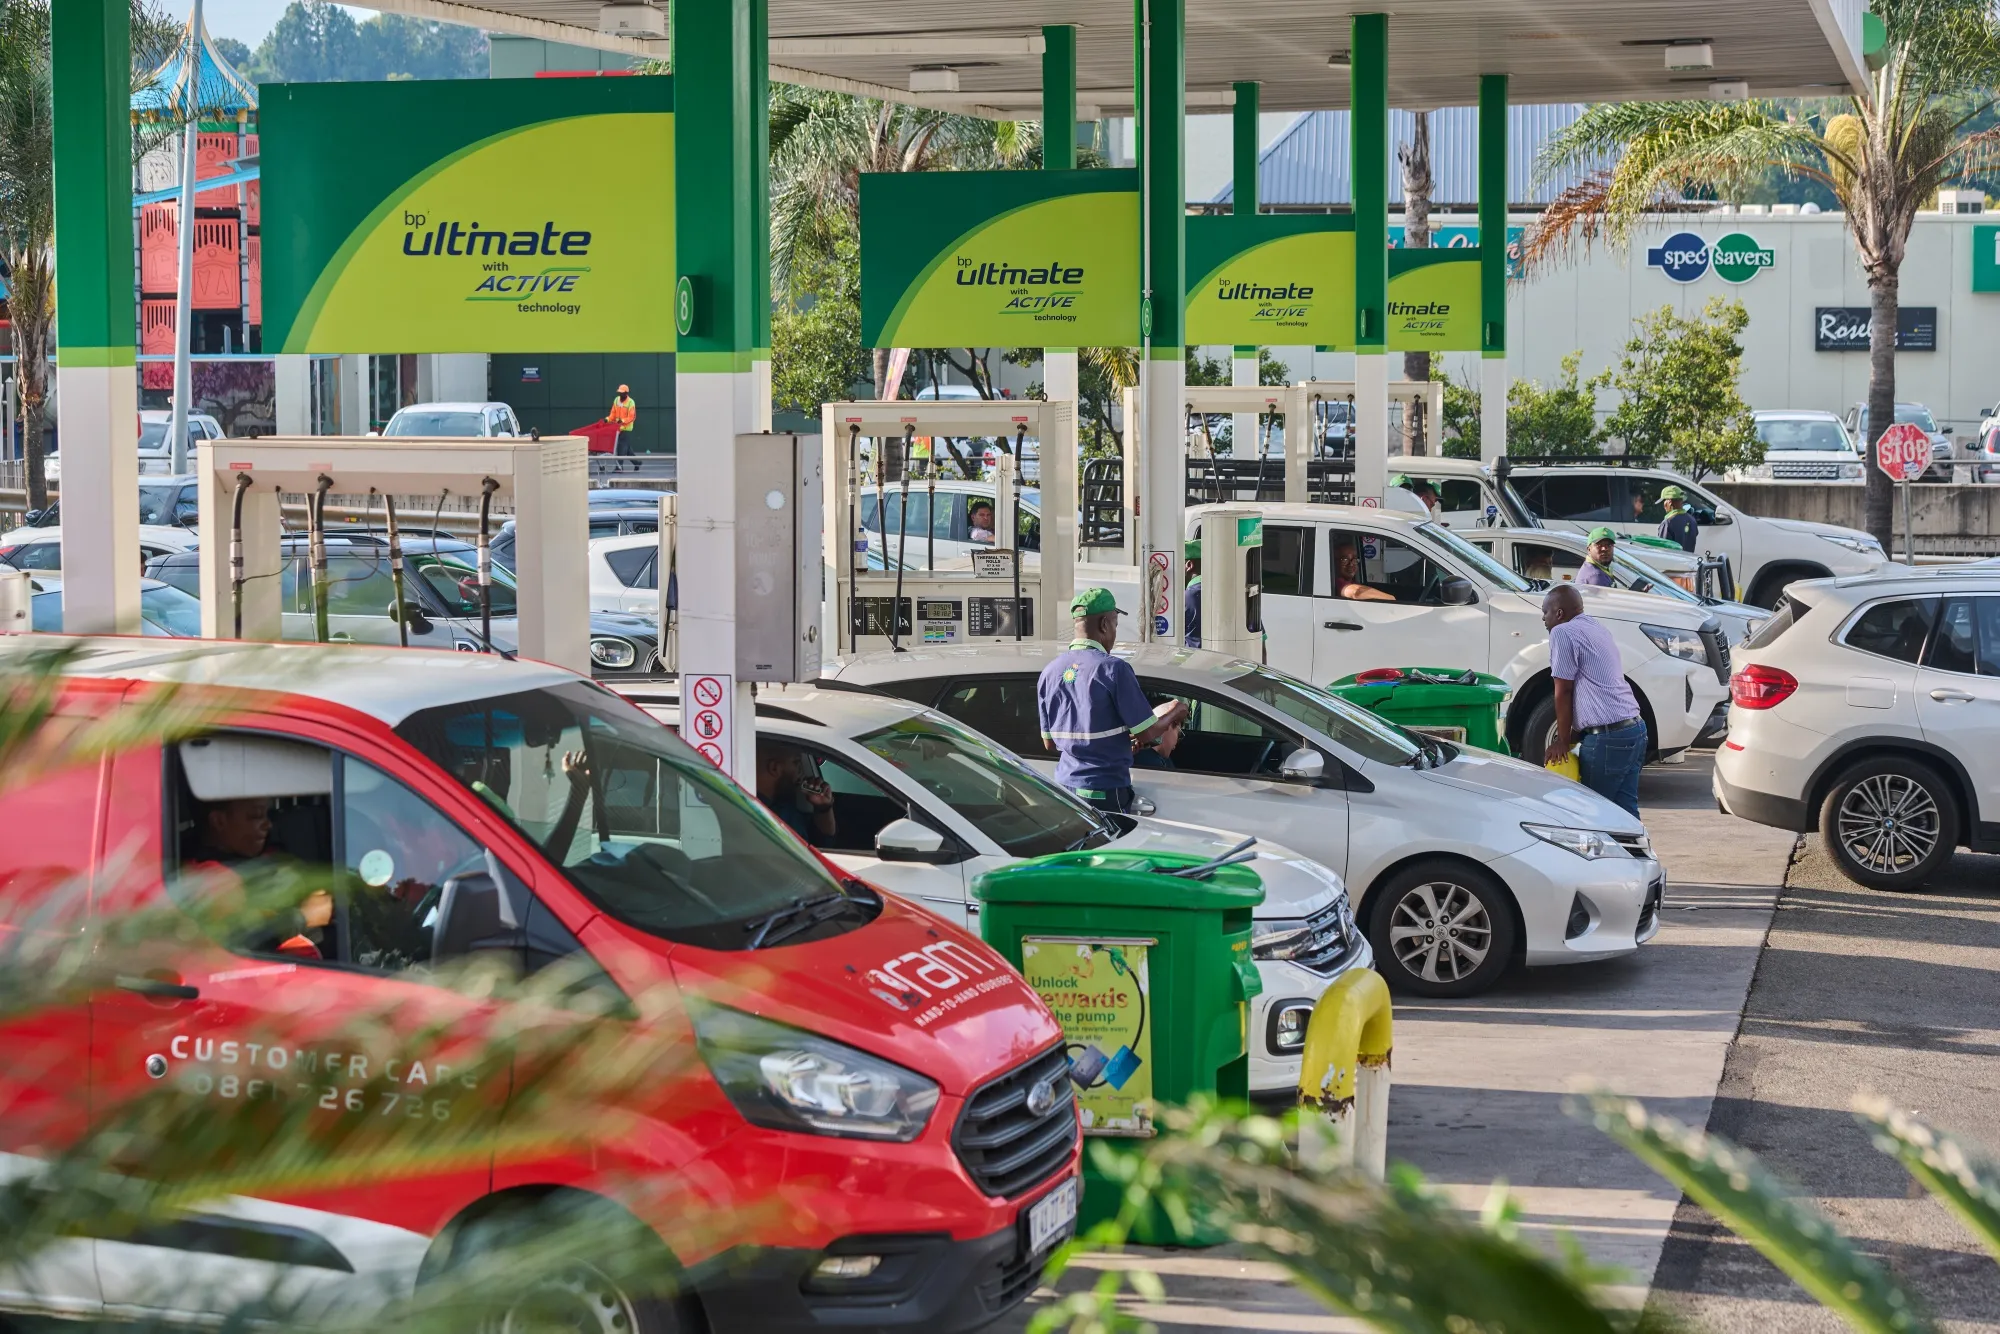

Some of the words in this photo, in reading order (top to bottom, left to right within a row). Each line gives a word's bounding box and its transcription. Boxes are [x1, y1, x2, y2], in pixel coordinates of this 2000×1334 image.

[404, 211, 426, 229] bp
[403, 221, 592, 256] ultimate
[482, 261, 509, 272] with
[957, 256, 972, 268] bp
[1664, 250, 1707, 270] spec
[1714, 251, 1771, 266] savers
[956, 262, 1084, 286] ultimate
[1219, 278, 1231, 287] bp
[475, 275, 581, 292] ACTIVE
[1218, 282, 1314, 300] ultimate
[518, 302, 581, 314] technology
[681, 290, 688, 321] 8
[1005, 296, 1076, 308] ACTIVE
[1387, 301, 1450, 316] ltimate
[1034, 314, 1077, 322] technology
[1255, 308, 1307, 317] ACTIVE
[1403, 321, 1445, 329] ACTIVE
[1881, 439, 1928, 465] STOP
[883, 940, 995, 998] ram
[1031, 976, 1078, 988] Unlock
[1039, 987, 1128, 1008] ewards
[914, 987, 979, 1027] HAND-TO-HAND
[1056, 1010, 1072, 1021] he
[1076, 1012, 1116, 1024] pump
[171, 1035, 368, 1080] CUSTOMER
